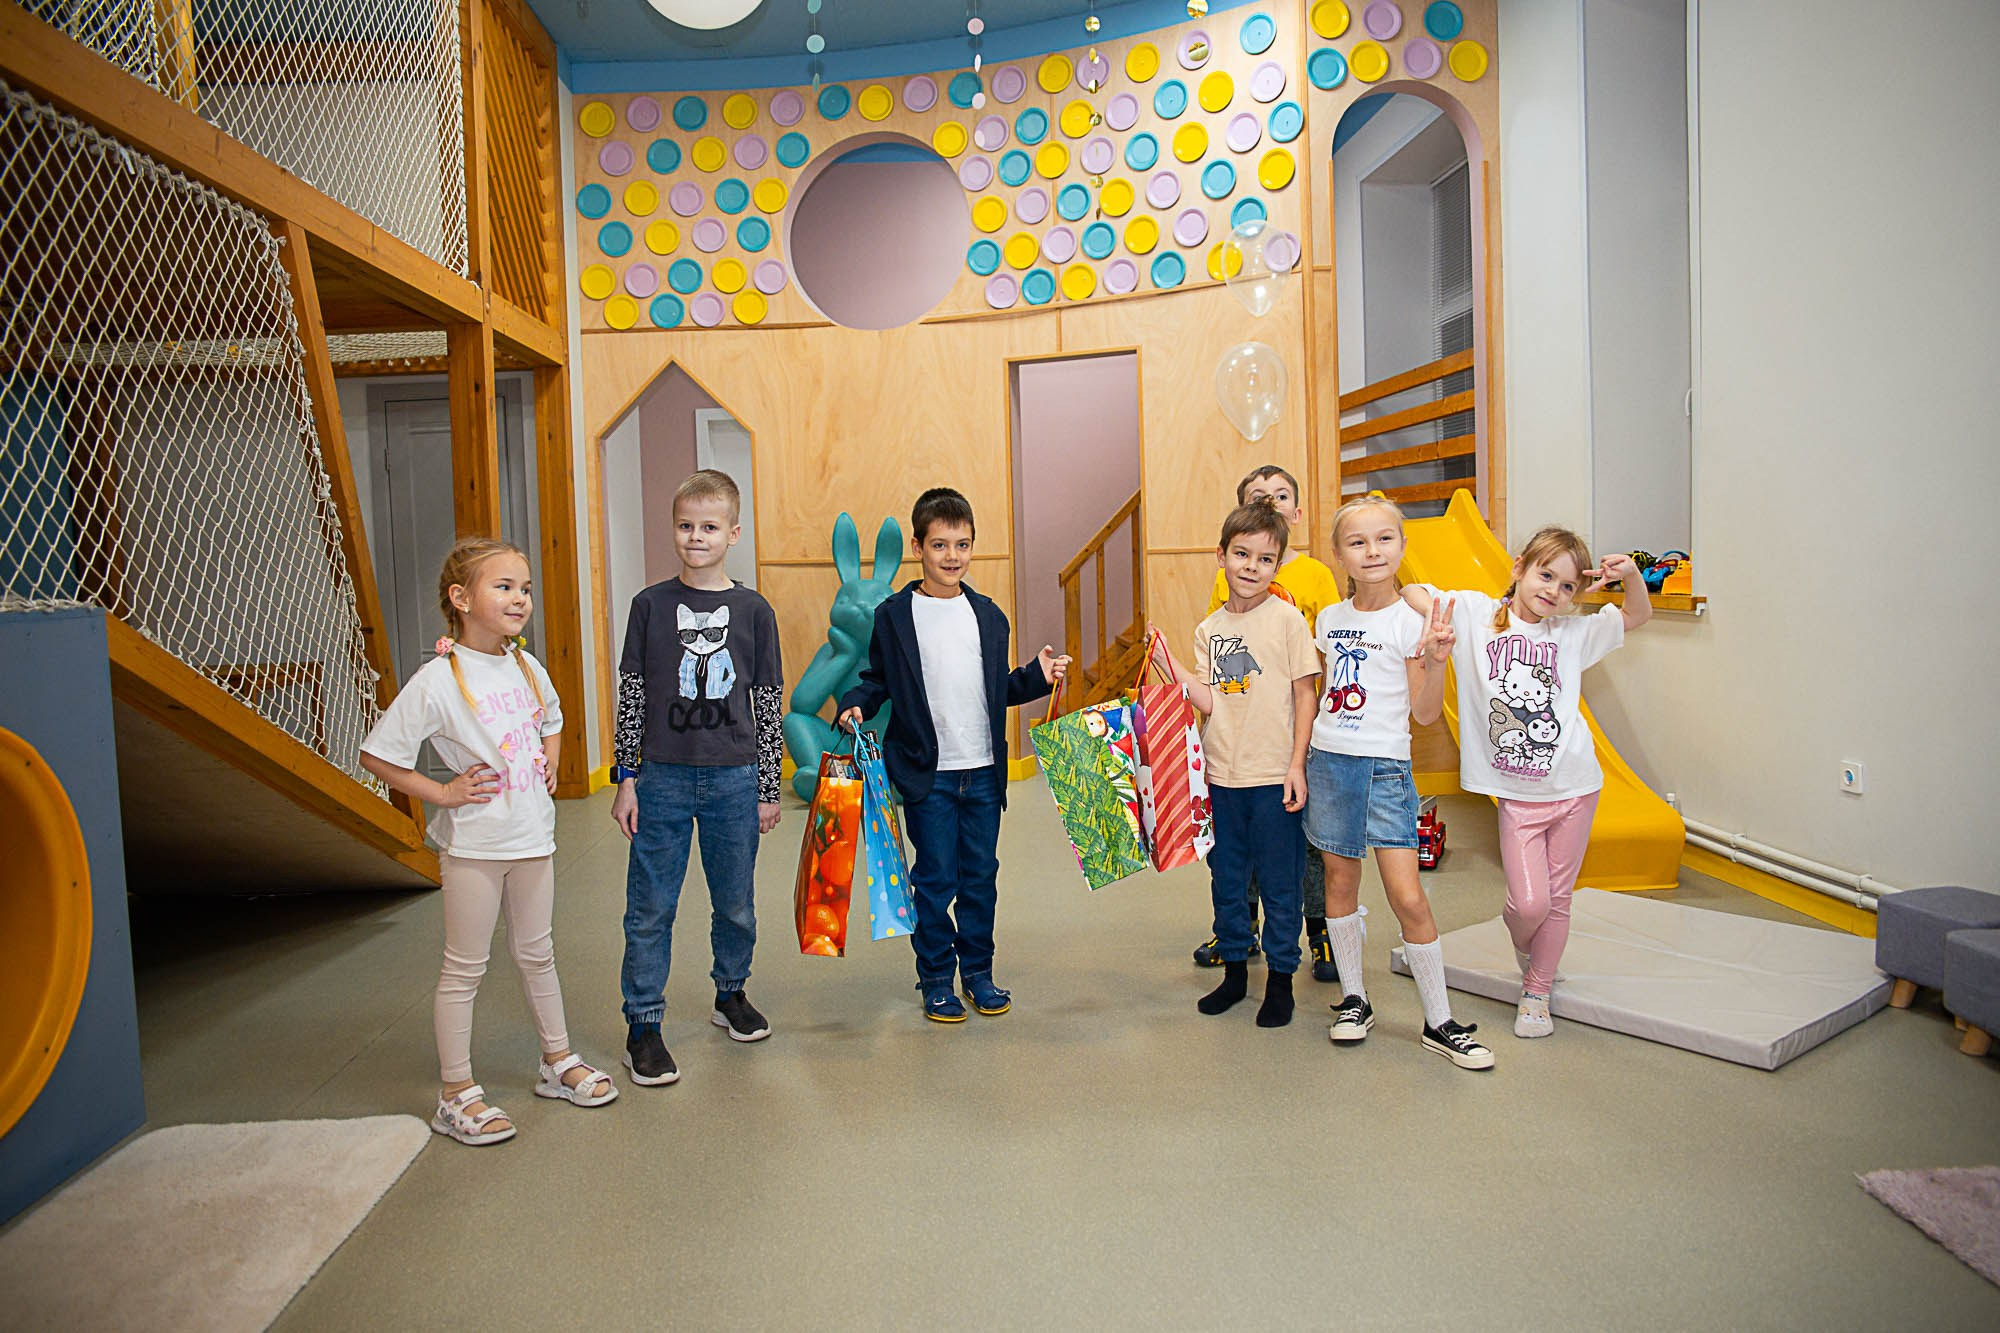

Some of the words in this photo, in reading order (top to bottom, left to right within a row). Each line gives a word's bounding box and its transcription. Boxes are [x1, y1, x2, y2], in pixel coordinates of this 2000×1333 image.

[1327, 629, 1366, 640] CHERRY
[1346, 636, 1383, 651] Flavour
[476, 686, 536, 725] ENERG
[668, 697, 738, 734] COOL
